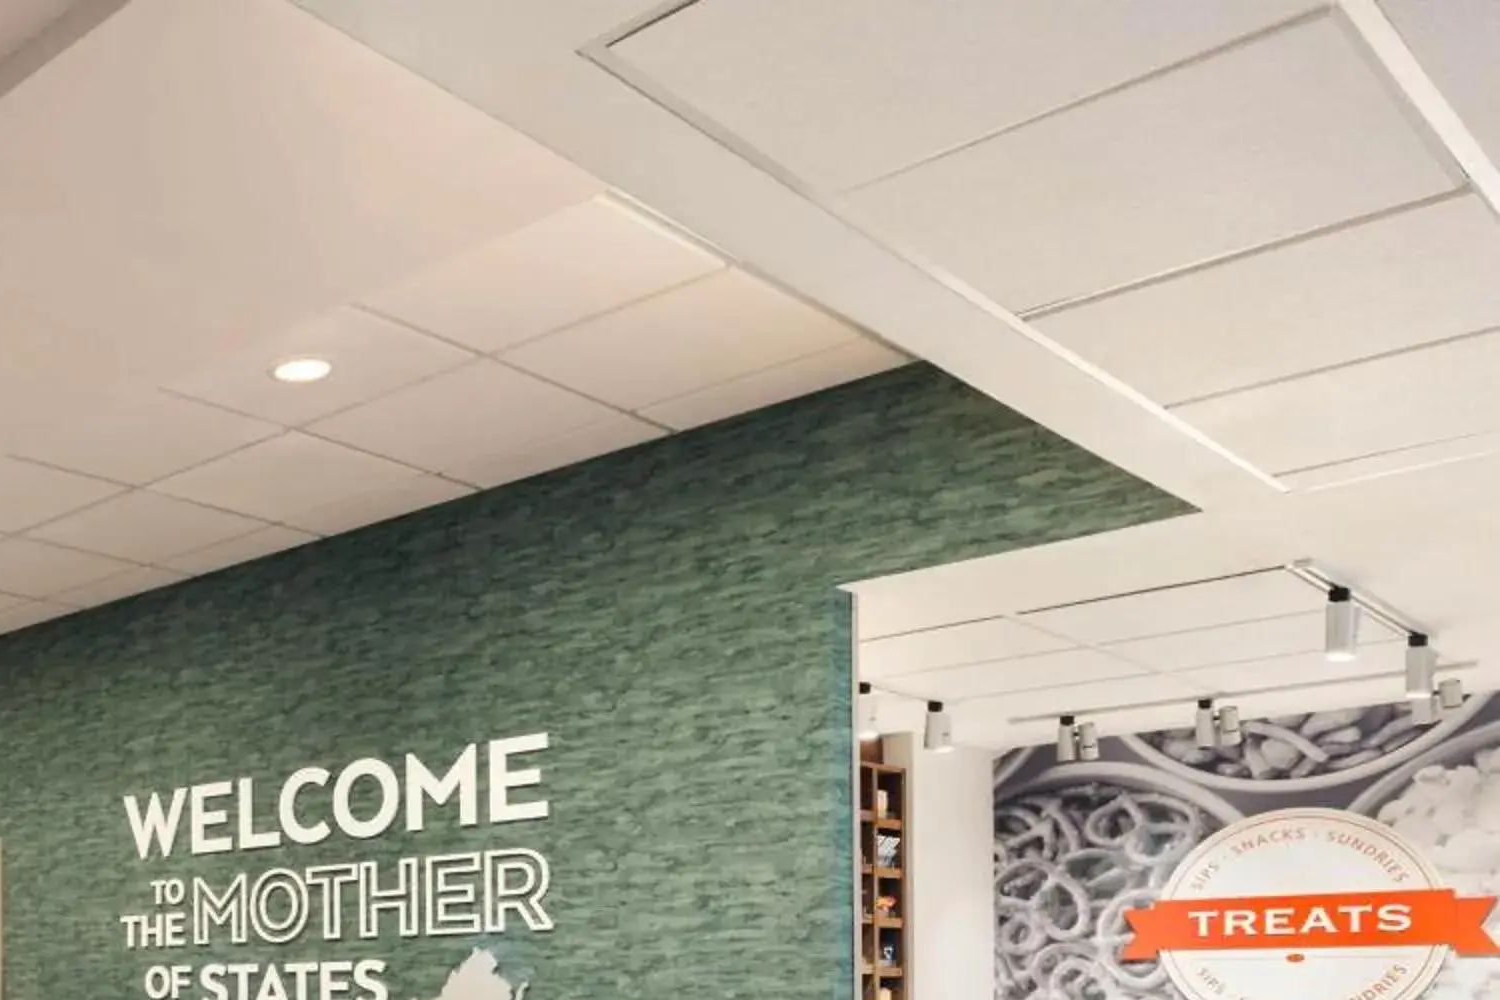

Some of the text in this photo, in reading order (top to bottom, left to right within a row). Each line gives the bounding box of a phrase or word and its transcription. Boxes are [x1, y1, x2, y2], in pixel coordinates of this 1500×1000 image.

[123, 732, 550, 860] WELCOME
[1190, 826, 1411, 892] SIPS SNACKS SUNDRIES
[120, 848, 555, 948] THE MOTHER
[150, 879, 186, 905] TO
[1187, 903, 1414, 938] TREATS
[145, 965, 192, 1000] OF
[1196, 965, 1224, 996] SIPS
